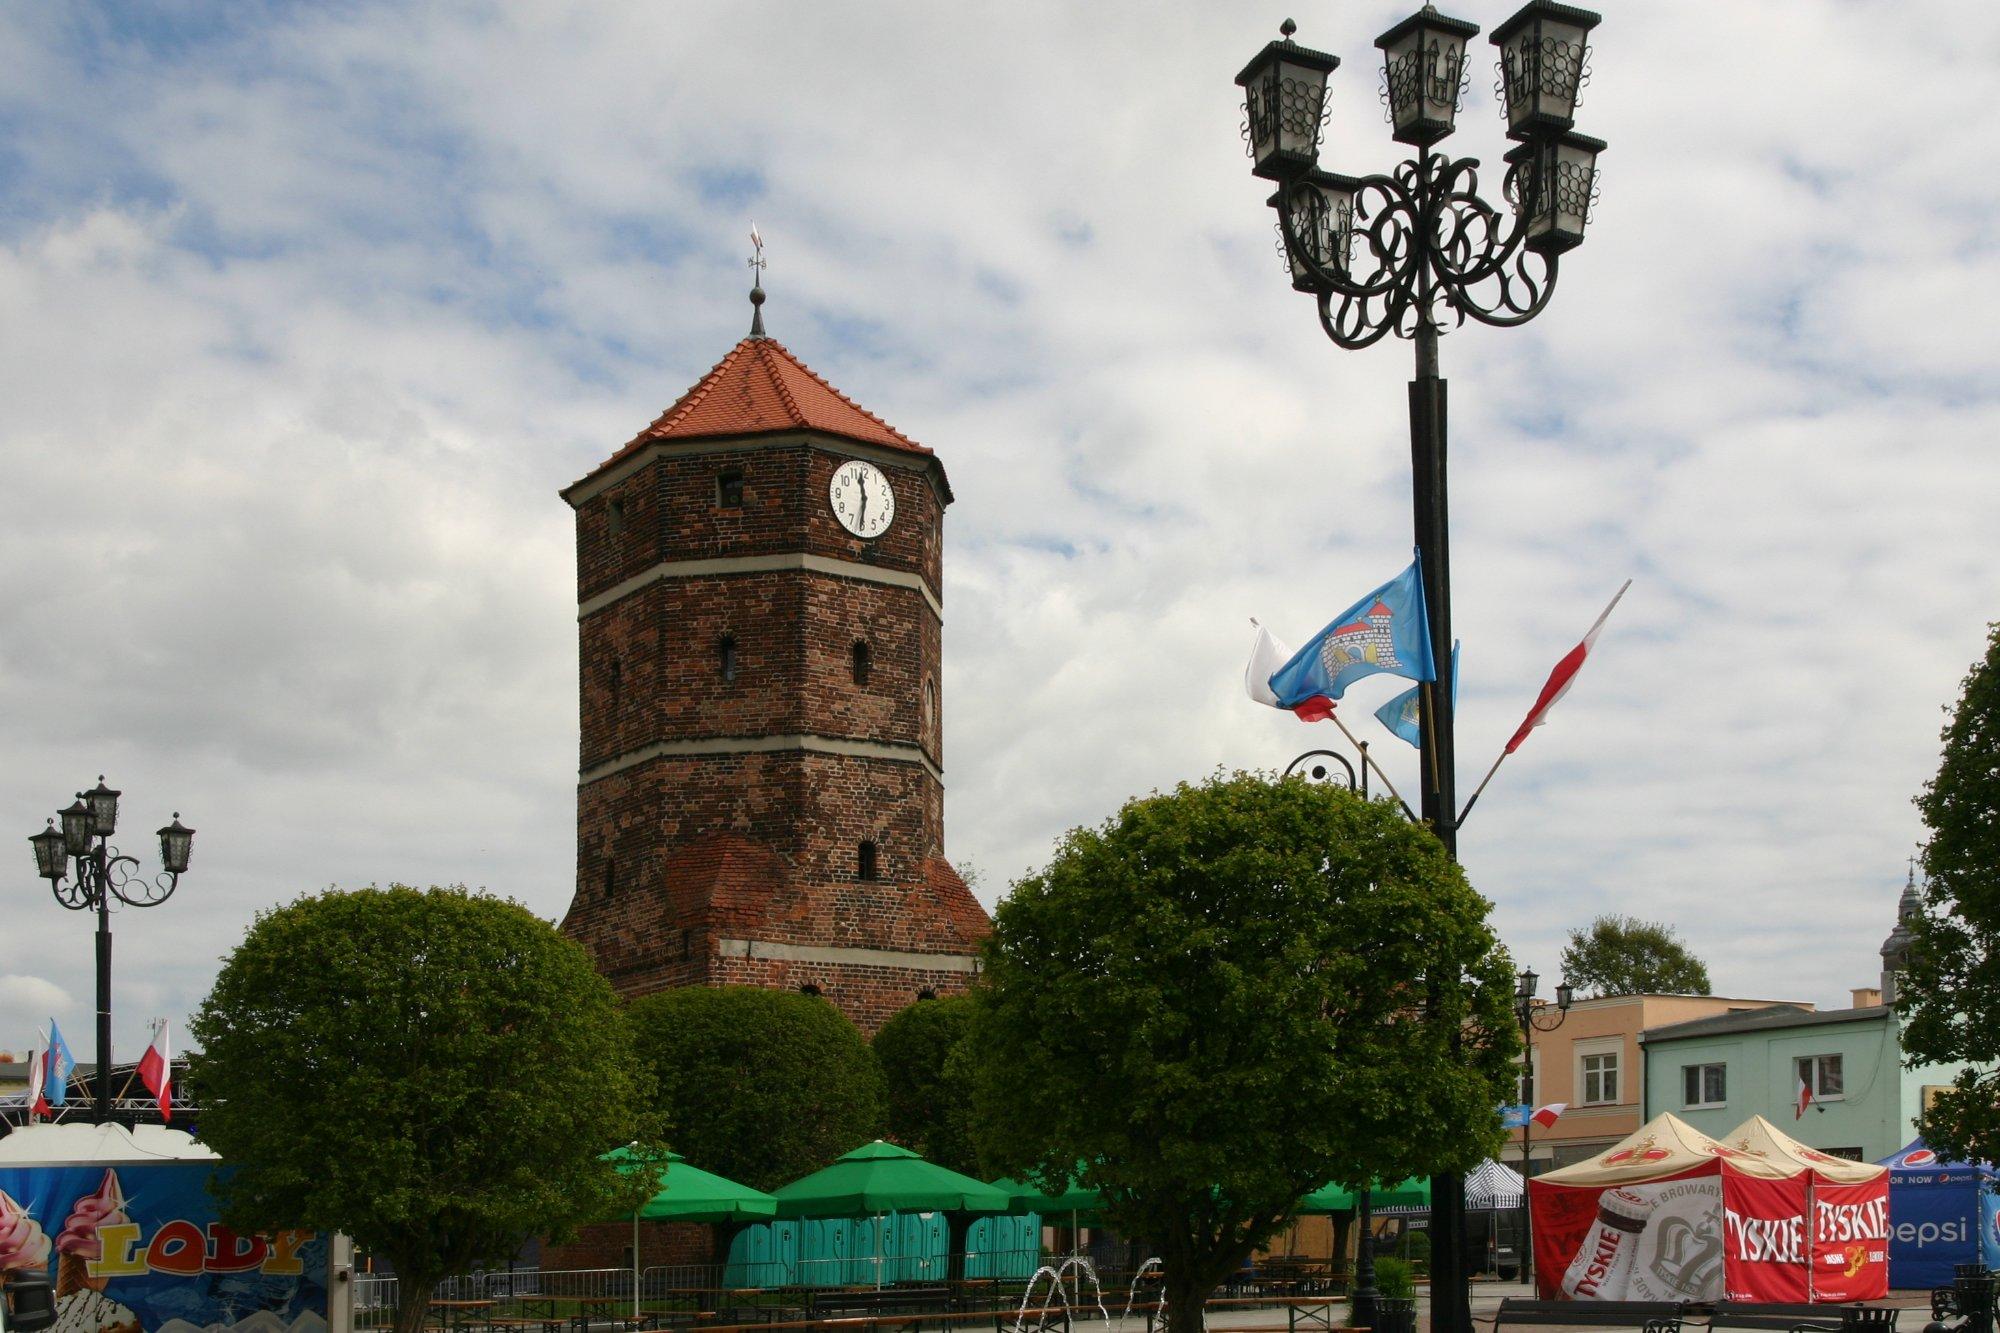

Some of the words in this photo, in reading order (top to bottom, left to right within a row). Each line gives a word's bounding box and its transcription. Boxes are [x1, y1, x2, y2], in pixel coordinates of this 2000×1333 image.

[850, 467, 857, 480] 11
[841, 474, 850, 487] 10
[835, 487, 841, 499] 9
[881, 485, 887, 497] 2
[839, 501, 845, 514] 8
[884, 499, 890, 511] 3
[849, 513, 854, 525] 7
[880, 512, 885, 523] 4
[871, 519, 876, 531] 5
[1889, 1176, 1904, 1185] OR
[1909, 1176, 1933, 1185] NOW
[1950, 1175, 1973, 1185] pepsi
[1816, 1195, 1888, 1242] TYSKIE
[1725, 1206, 1805, 1263] TYSKIE
[85, 1219, 316, 1278] LODY
[1573, 1228, 1621, 1297] TYSKIE
